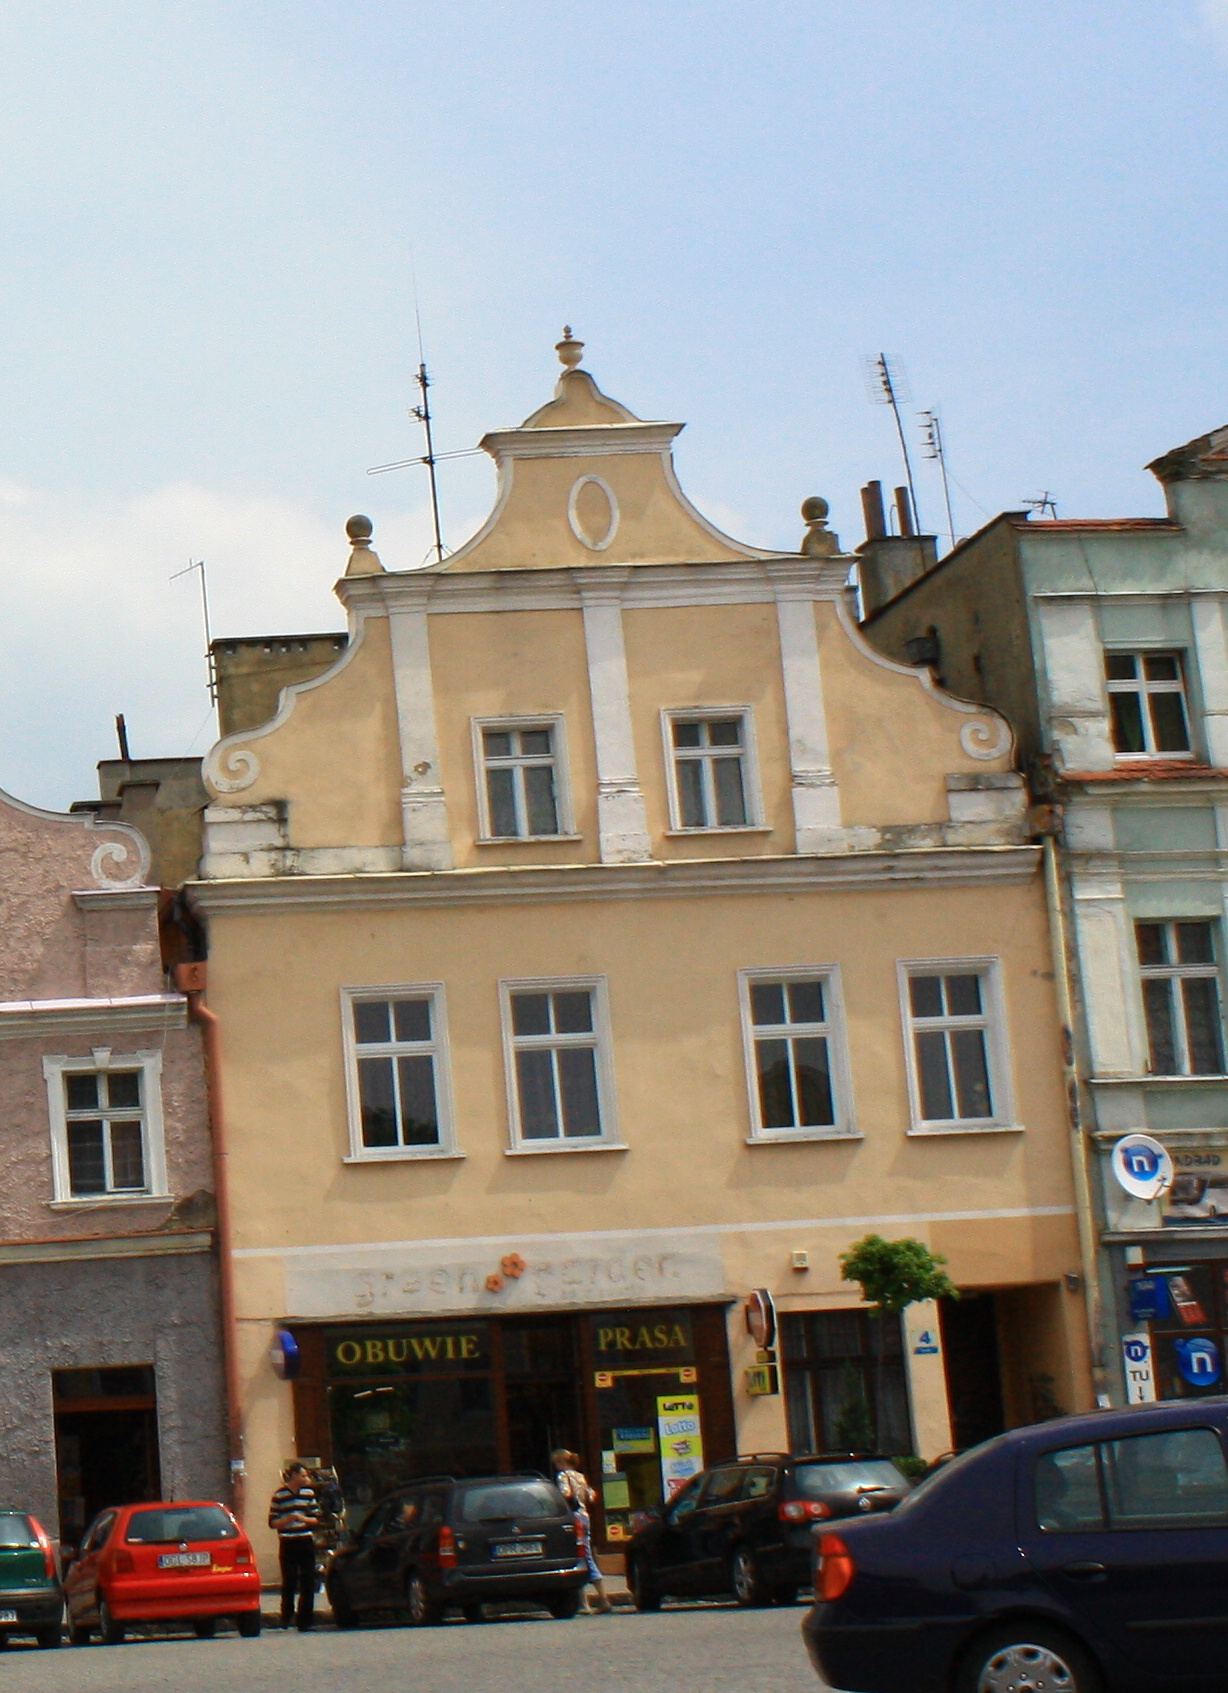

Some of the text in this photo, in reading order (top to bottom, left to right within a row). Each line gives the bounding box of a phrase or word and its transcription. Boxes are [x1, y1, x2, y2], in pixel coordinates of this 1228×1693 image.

[600, 1324, 688, 1351] PRASA
[919, 1330, 931, 1345] 4
[336, 1335, 480, 1365] OBUWIE
[1129, 1369, 1149, 1382] TU
